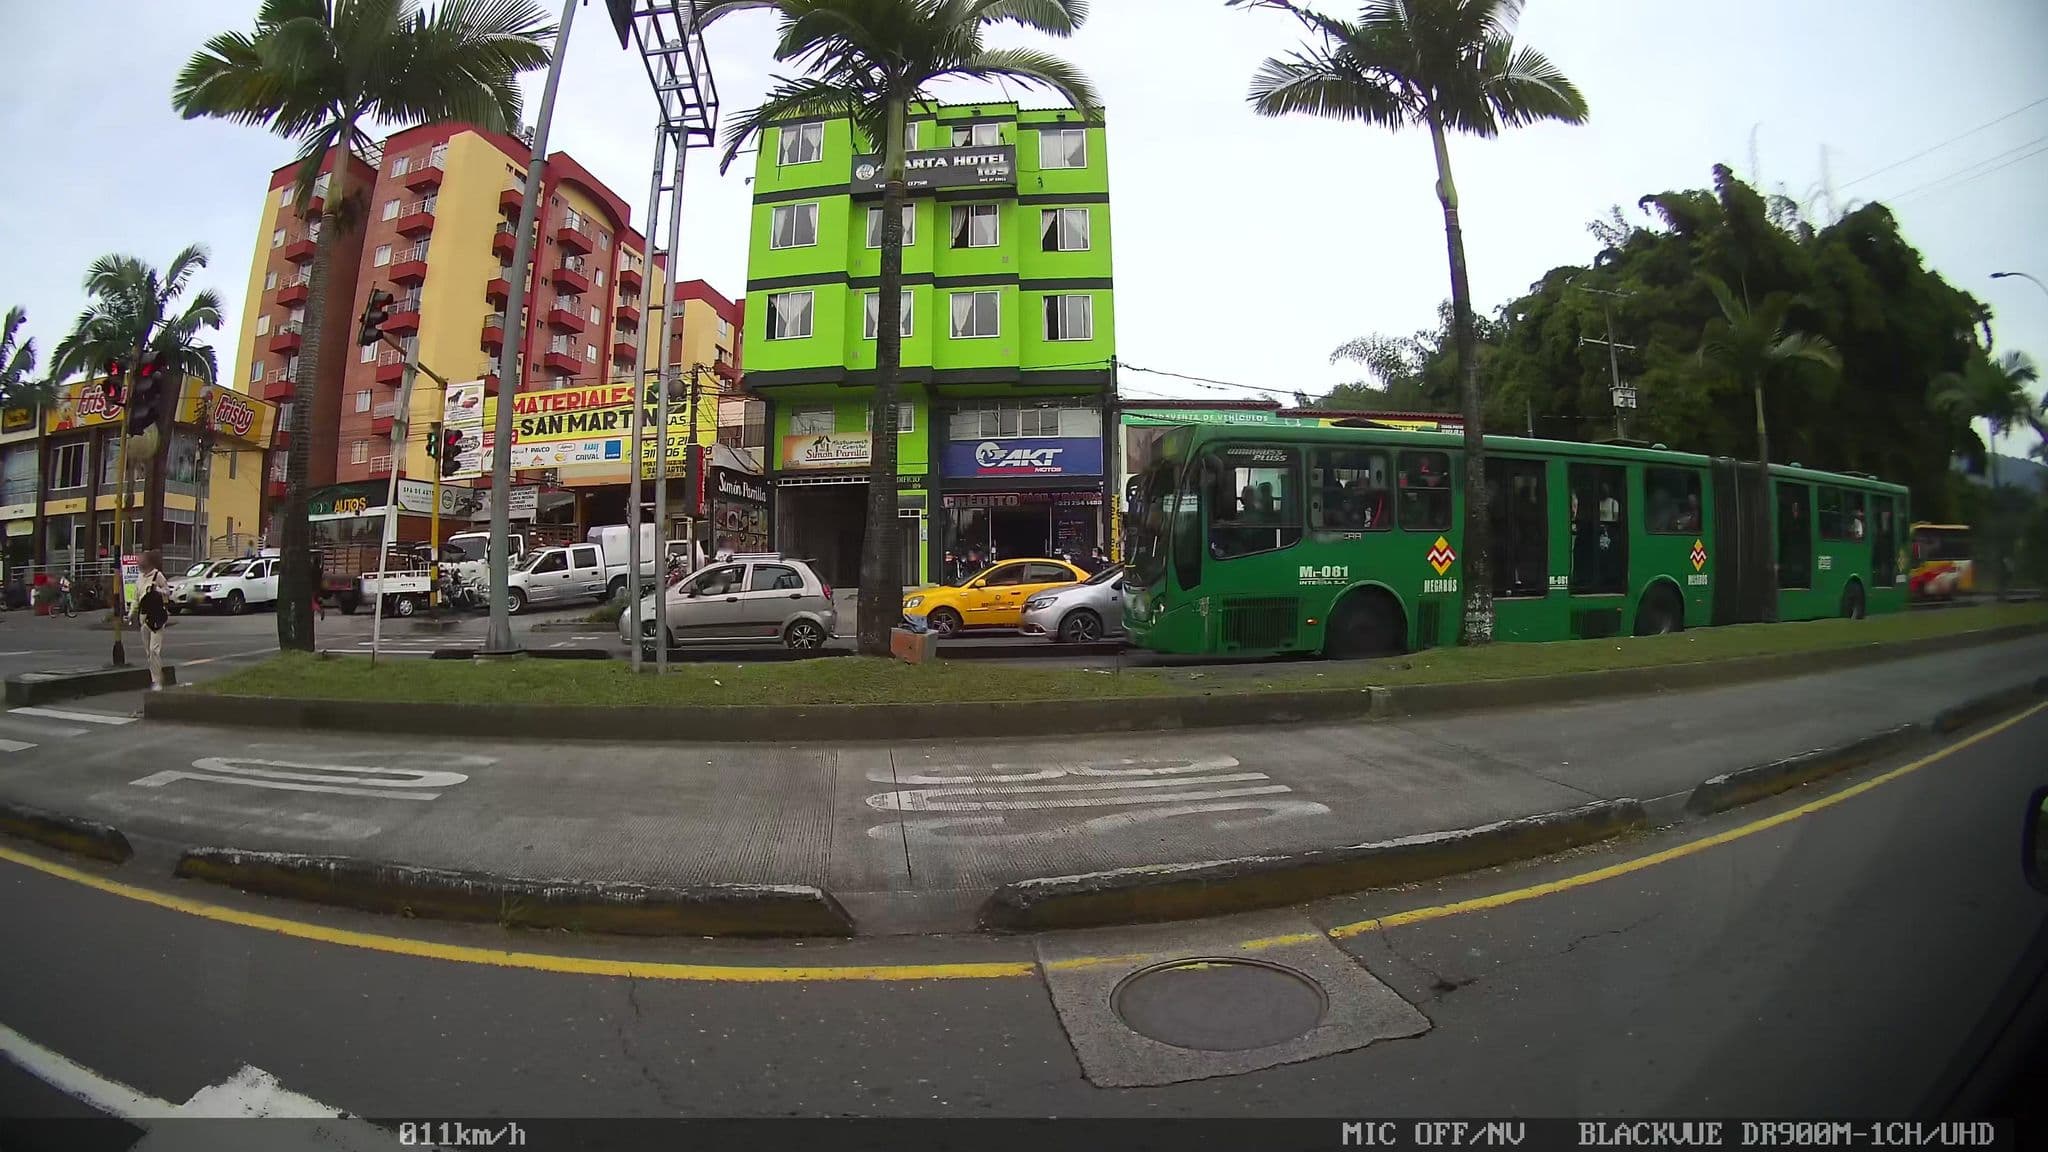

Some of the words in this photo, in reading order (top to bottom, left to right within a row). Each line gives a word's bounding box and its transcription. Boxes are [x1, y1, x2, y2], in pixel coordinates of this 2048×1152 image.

[953, 153, 1008, 167] HOTEL
[76, 384, 128, 419] Frisy
[512, 387, 635, 414] MATERIALES
[215, 395, 254, 436] Frisby
[520, 414, 563, 437] SAN
[567, 407, 658, 433] MARTN
[999, 449, 1063, 466] AKT
[334, 497, 367, 513] AUTOS
[943, 493, 1018, 508] CRÉDITO
[1299, 565, 1349, 577] M-081
